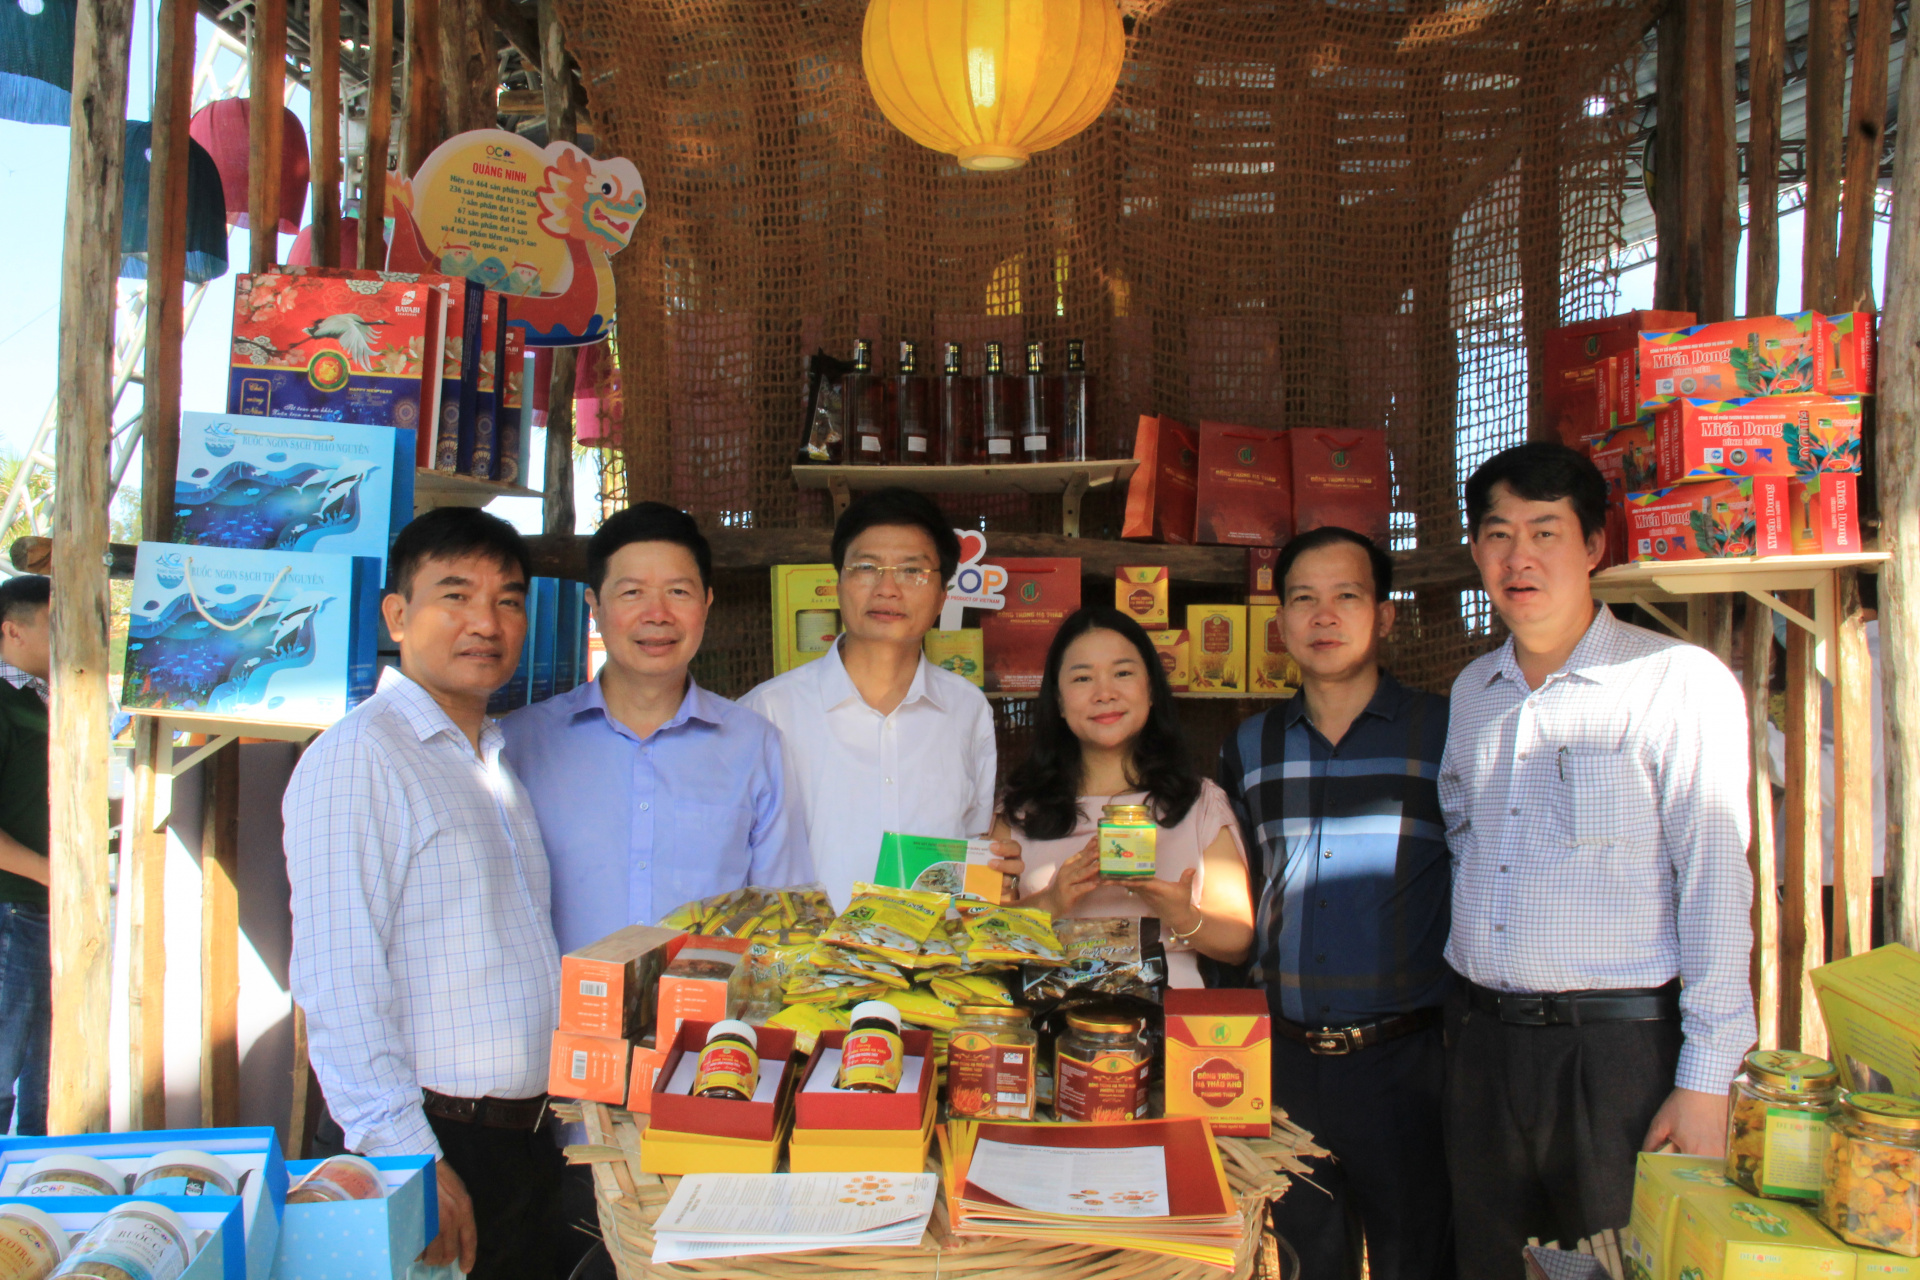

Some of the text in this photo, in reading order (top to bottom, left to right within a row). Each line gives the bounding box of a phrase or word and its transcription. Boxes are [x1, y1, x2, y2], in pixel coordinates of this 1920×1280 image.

[473, 161, 526, 183] QUẢNG NINH
[1654, 348, 1730, 368] Miến Dong
[1702, 422, 1783, 438] Miến Dong
[1635, 511, 1690, 528] Miến Dong
[1765, 484, 1777, 549] Miến Dong
[1836, 480, 1848, 545] Miến Dong
[958, 569, 1003, 595] OP
